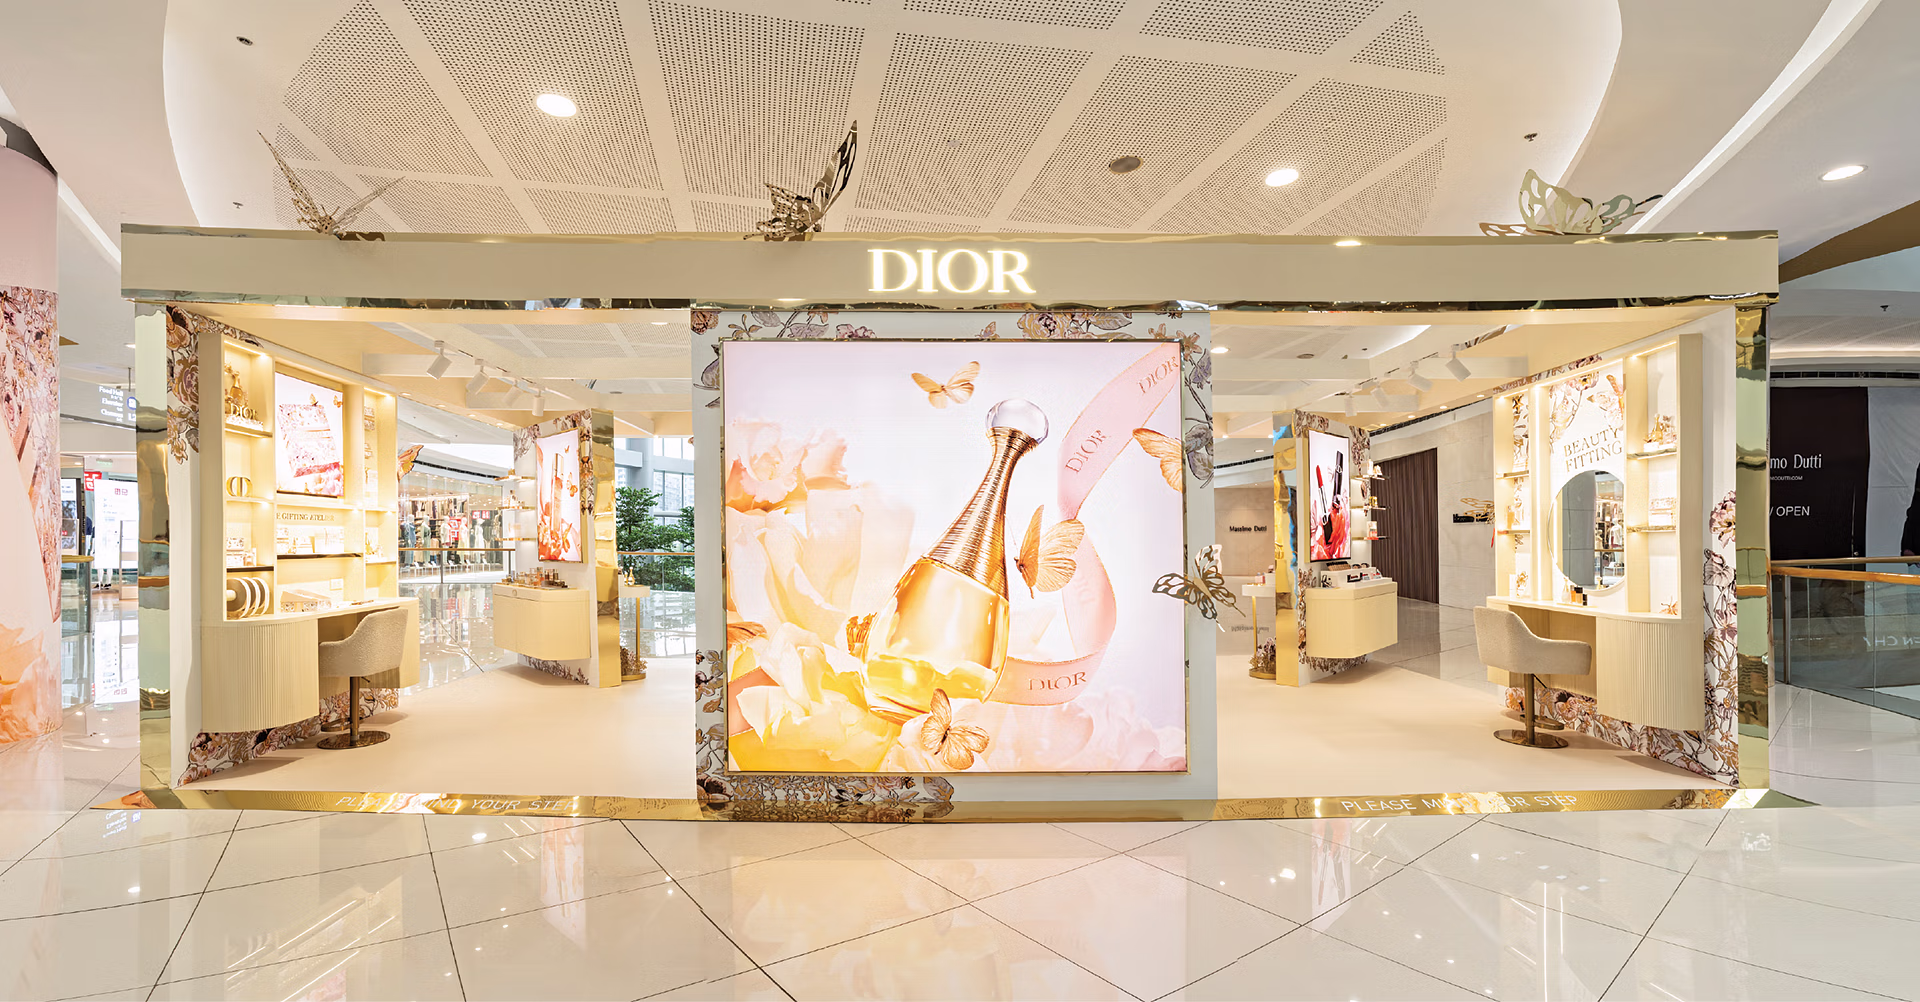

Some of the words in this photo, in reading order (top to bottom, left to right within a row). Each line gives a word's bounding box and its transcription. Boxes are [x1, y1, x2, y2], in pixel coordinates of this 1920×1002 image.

[867, 248, 1037, 294] DIOR
[1137, 356, 1179, 394] DIOR
[229, 403, 259, 422] DIOR
[1563, 424, 1618, 458] BEAUTY
[1064, 429, 1109, 474] DIOR
[1565, 440, 1623, 473] FITTING
[1793, 453, 1822, 469] Dutti
[1776, 505, 1811, 517] OPEN
[1028, 671, 1087, 691] DIOR
[470, 798, 521, 810] YOUR
[528, 800, 579, 811] STEP
[1341, 799, 1417, 812] PLEASE
[1534, 795, 1578, 807] STEP
